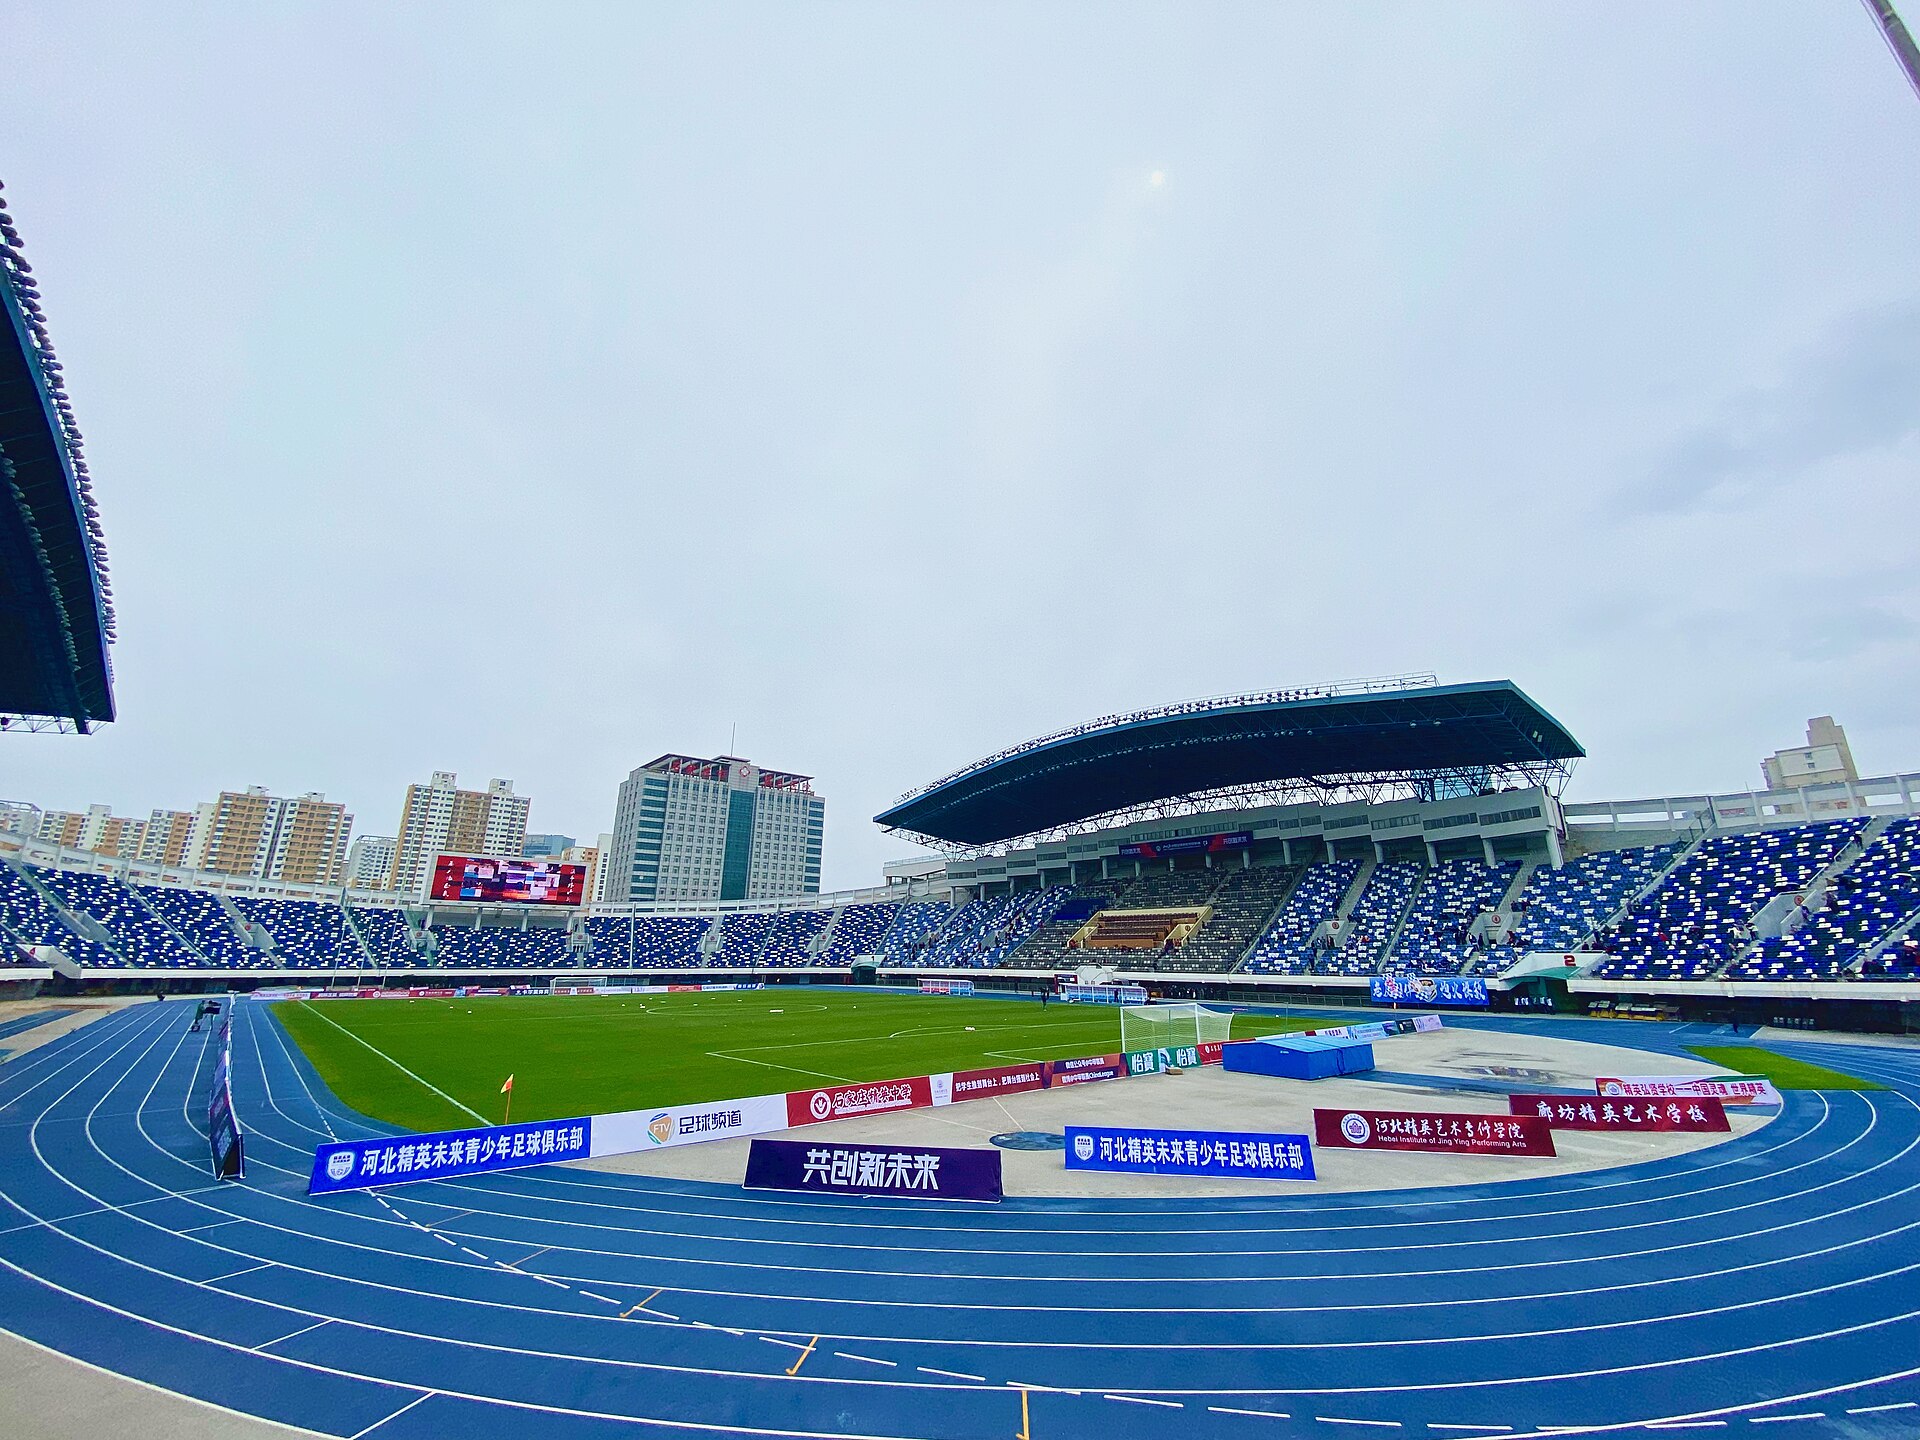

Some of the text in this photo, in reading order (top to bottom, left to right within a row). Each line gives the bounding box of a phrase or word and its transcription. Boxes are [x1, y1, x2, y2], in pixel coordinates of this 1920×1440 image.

[1563, 954, 1577, 967] 2
[1131, 1052, 1155, 1073] 怡寶
[1176, 1047, 1198, 1067] 怡寶
[832, 1083, 912, 1109] 石家庄精英中学
[1731, 1082, 1767, 1095] 世界精英
[679, 1109, 742, 1135] 足球频道
[1538, 1101, 1708, 1124] 廊坊精英艺术学校
[653, 1122, 670, 1133] FTV
[1375, 1117, 1524, 1139] 河北精英艺术专修学院
[360, 1126, 584, 1177] 河北精英未来青少年足球俱乐部
[1099, 1135, 1304, 1170] 河北精英未来青少年足球俱乐部
[1378, 1135, 1398, 1143] Hebei
[1399, 1136, 1427, 1144] Institute
[1437, 1138, 1453, 1146] Jing
[1454, 1138, 1470, 1147] Ying
[1472, 1139, 1511, 1148] Performing
[1512, 1141, 1527, 1149] Arts
[802, 1149, 940, 1190] 共创新未来
